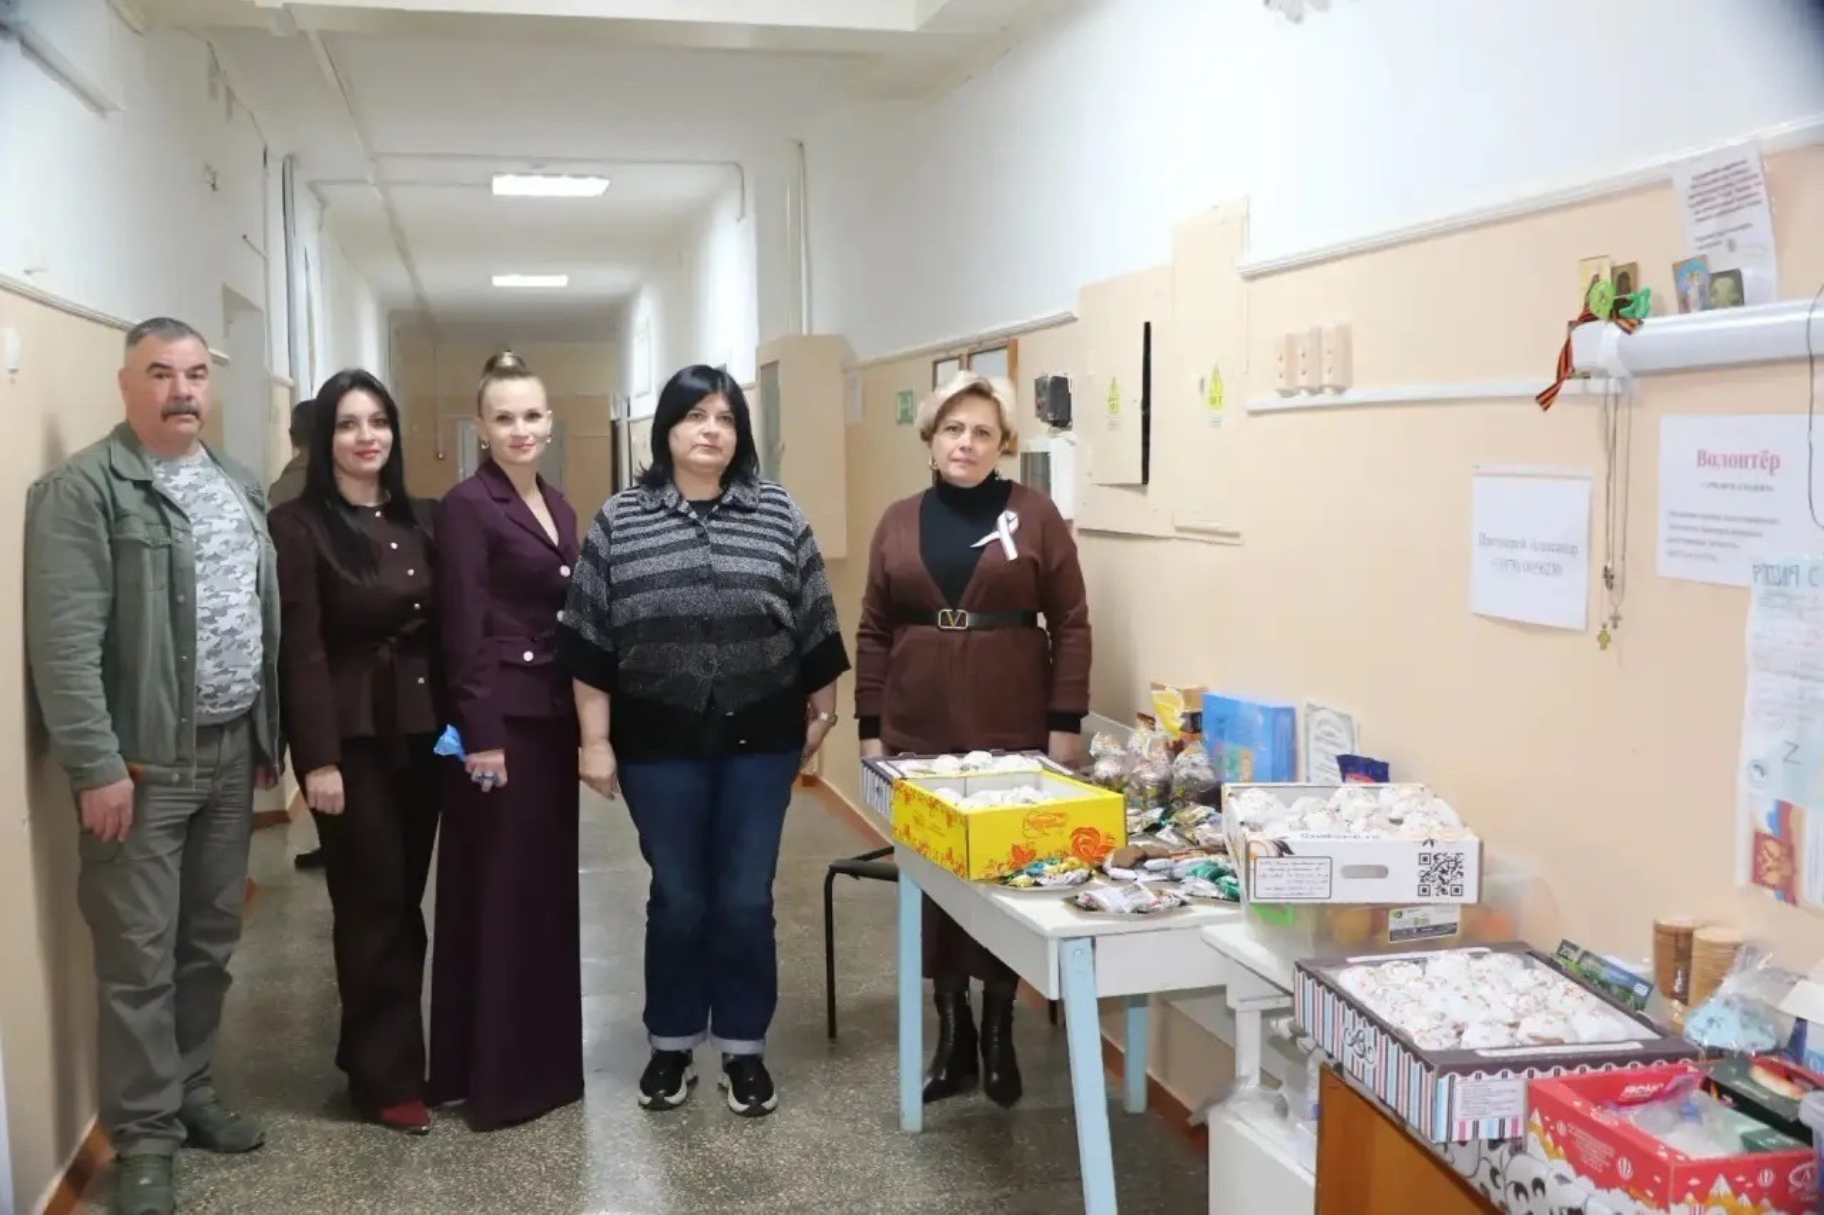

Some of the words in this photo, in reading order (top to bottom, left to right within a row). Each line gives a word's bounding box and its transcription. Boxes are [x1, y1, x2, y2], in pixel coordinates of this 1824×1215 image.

[1696, 449, 1781, 476] Волонтёр
[1478, 532, 1527, 550] Проиерей
[1529, 538, 1579, 558] Алексар
